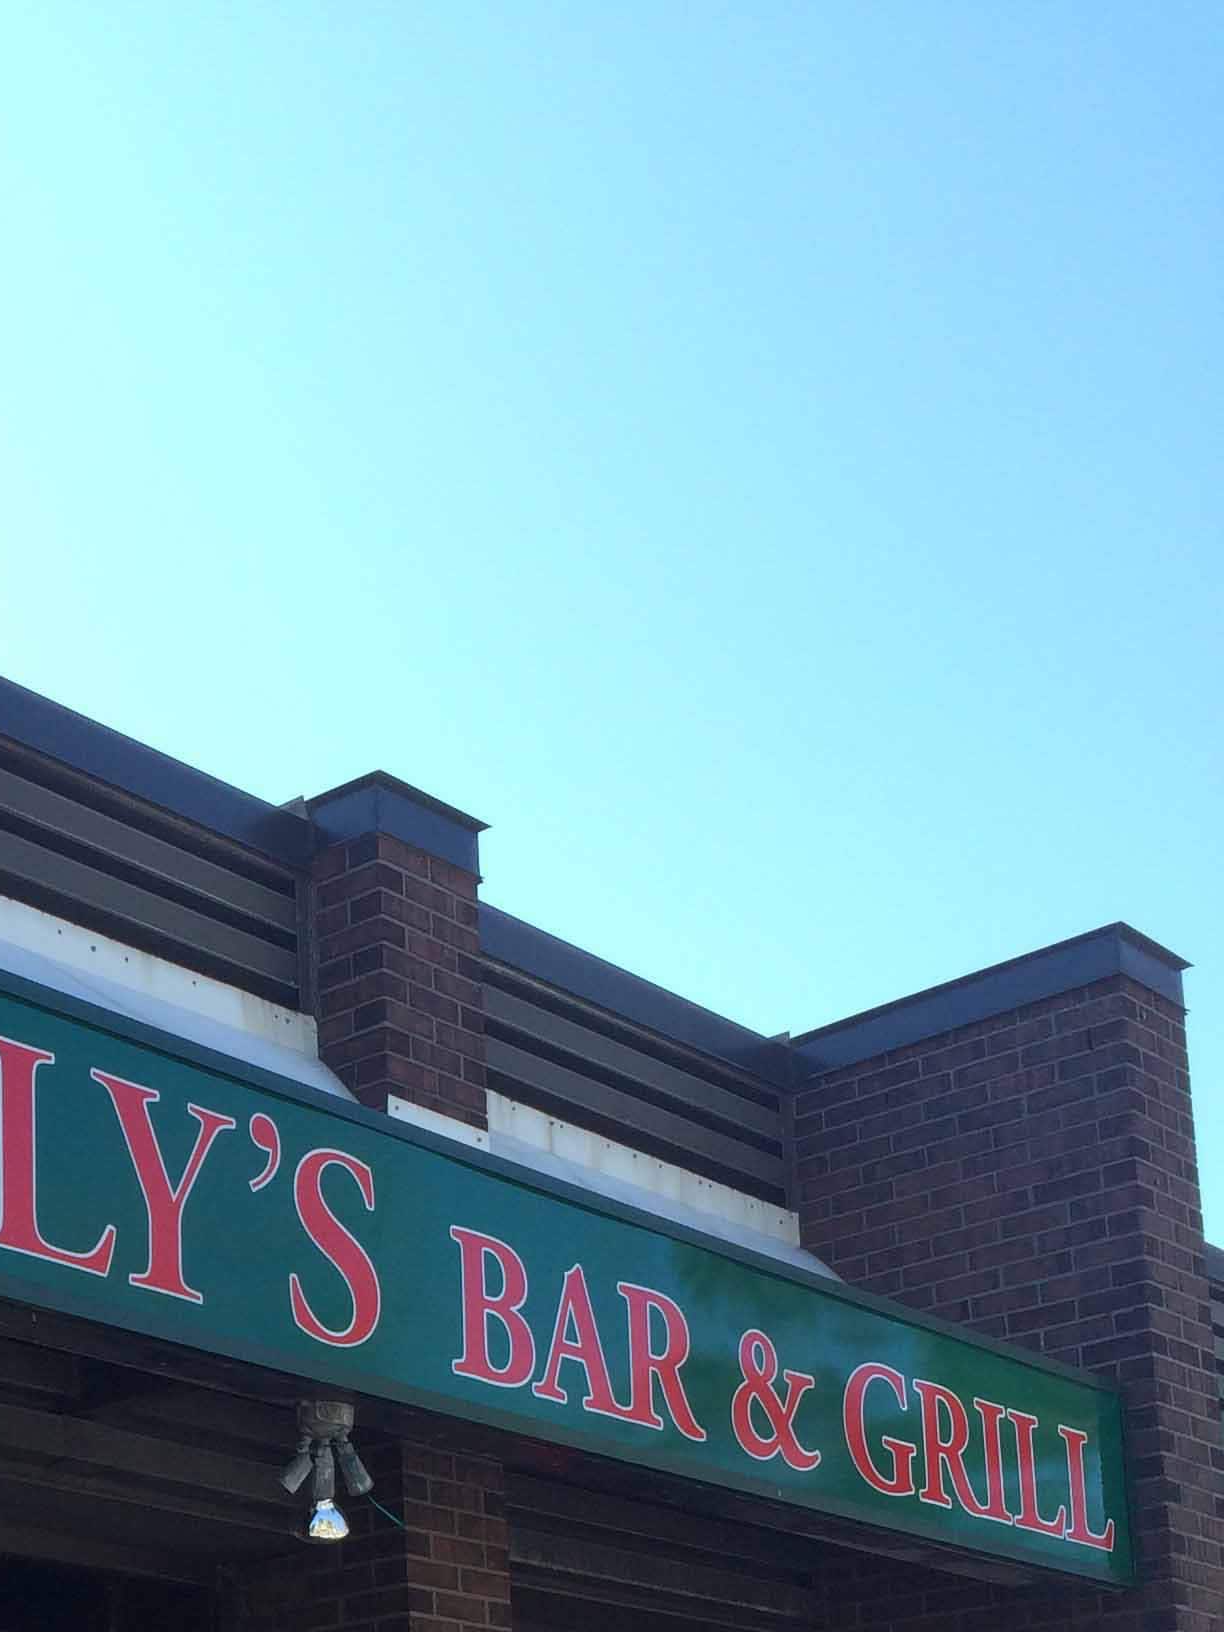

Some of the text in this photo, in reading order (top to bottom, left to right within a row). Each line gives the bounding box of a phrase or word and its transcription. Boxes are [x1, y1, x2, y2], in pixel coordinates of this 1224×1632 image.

[450, 1225, 706, 1442] BAR
[731, 1329, 821, 1471] &
[843, 1362, 1115, 1552] GRILL
